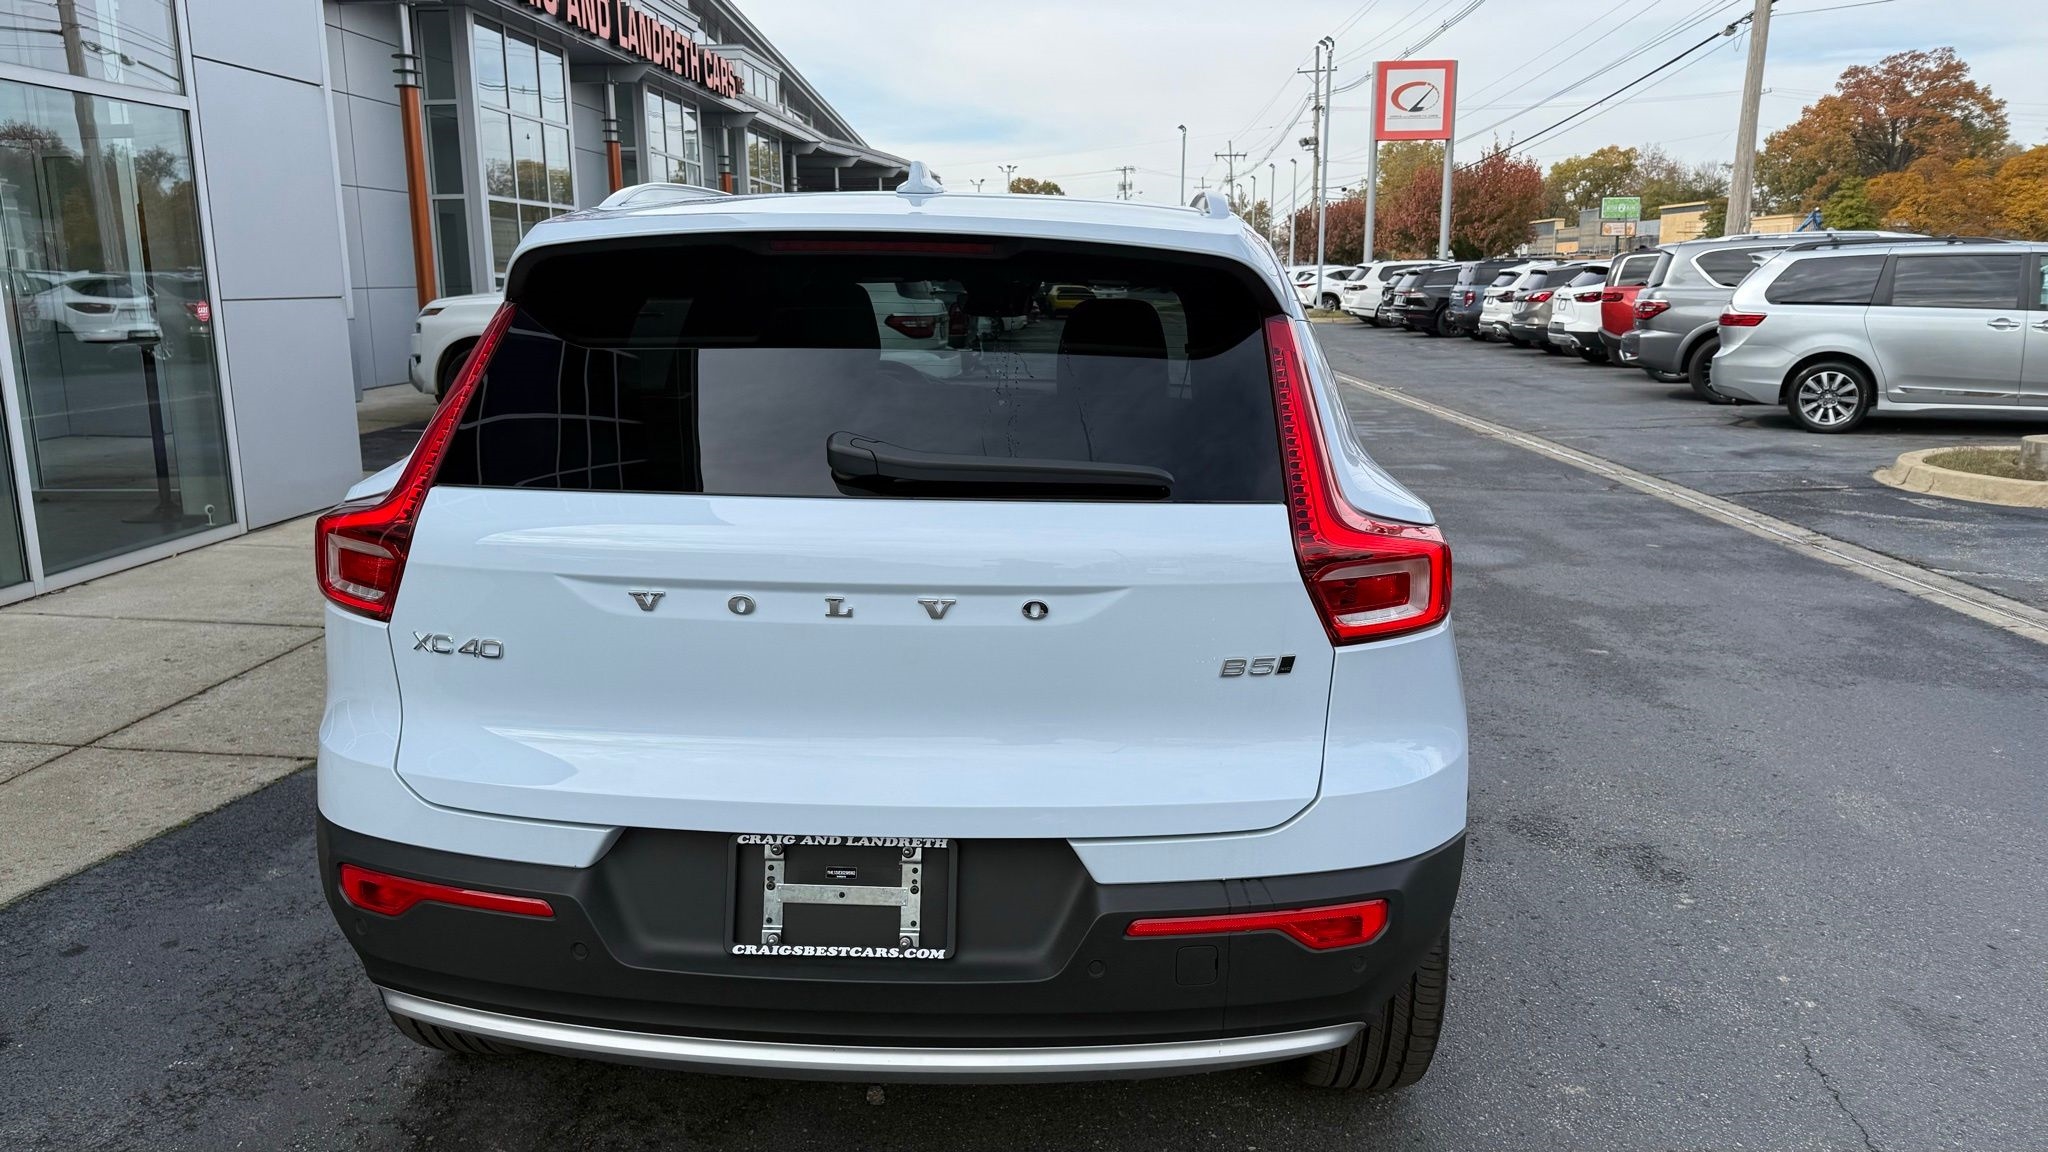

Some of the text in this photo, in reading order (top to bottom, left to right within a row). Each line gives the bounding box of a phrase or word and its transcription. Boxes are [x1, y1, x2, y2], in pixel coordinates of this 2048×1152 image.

[617, 0, 700, 83] LANDRETH
[704, 48, 737, 99] CARS
[628, 590, 1049, 621] VOLVO
[412, 631, 504, 660] XC40
[1219, 656, 1276, 677] B5
[736, 834, 949, 849] CRAIG AND LANDRETH
[731, 944, 947, 960] CRAIGSBESTCARS.COM
